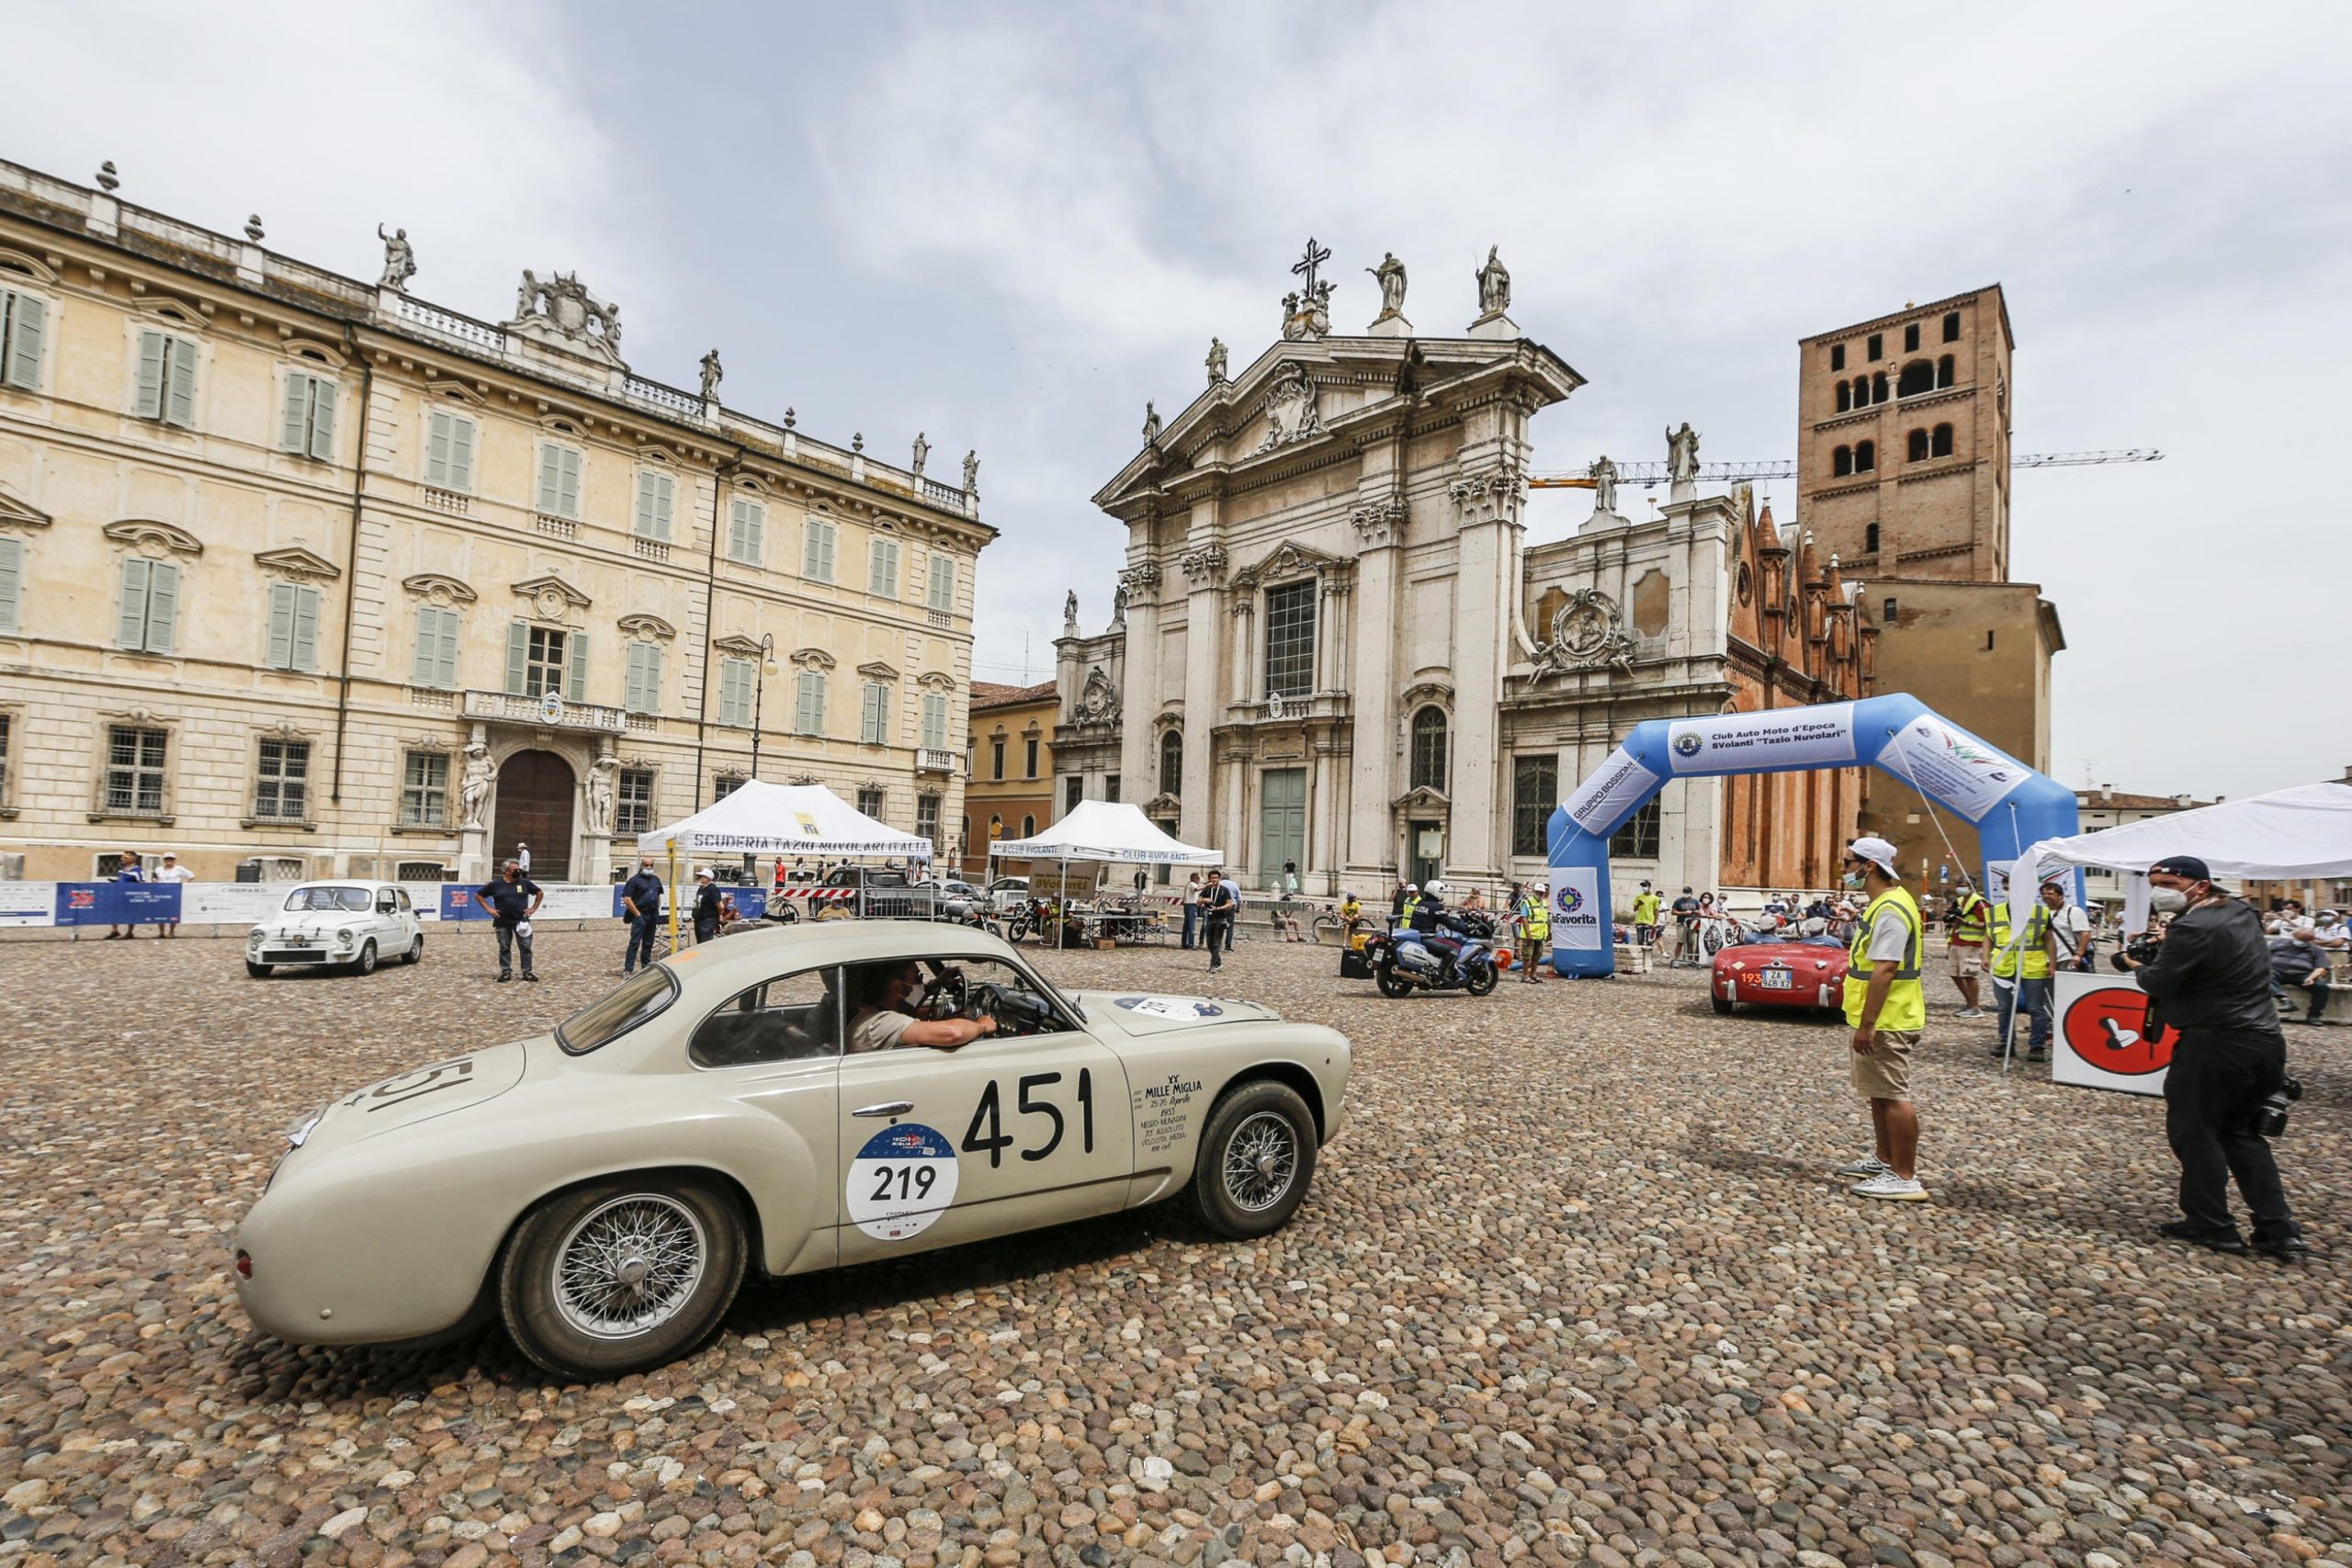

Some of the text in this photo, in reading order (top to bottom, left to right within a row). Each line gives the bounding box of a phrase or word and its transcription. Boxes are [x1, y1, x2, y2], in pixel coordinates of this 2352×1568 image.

[1736, 730, 1759, 739] Auto
[1763, 728, 1789, 736] Moto
[1792, 722, 1836, 733] d'Epoca
[1712, 729, 1847, 750] 8Volanti "Tazio Nuvolari"
[1574, 791, 1604, 818] GRUPPO
[694, 833, 768, 849] SCUDERIA
[775, 838, 815, 851] TAZIO
[1007, 845, 1024, 854] CLUB
[1123, 850, 1146, 861] CLUB
[1941, 865, 1948, 877] P
[1035, 880, 1088, 890] 8Volnti
[1741, 973, 1762, 983] 193
[1770, 971, 1781, 979] ZA
[1762, 979, 1791, 988] 948 XZ
[1146, 1080, 1202, 1100] MILLE MIGLIA
[1170, 1094, 1190, 1106] Aprile
[961, 1067, 1093, 1168] 451
[1160, 1108, 1175, 1117] 1953
[1156, 1123, 1184, 1135] ASSOLUTO
[869, 1165, 936, 1201] 219
